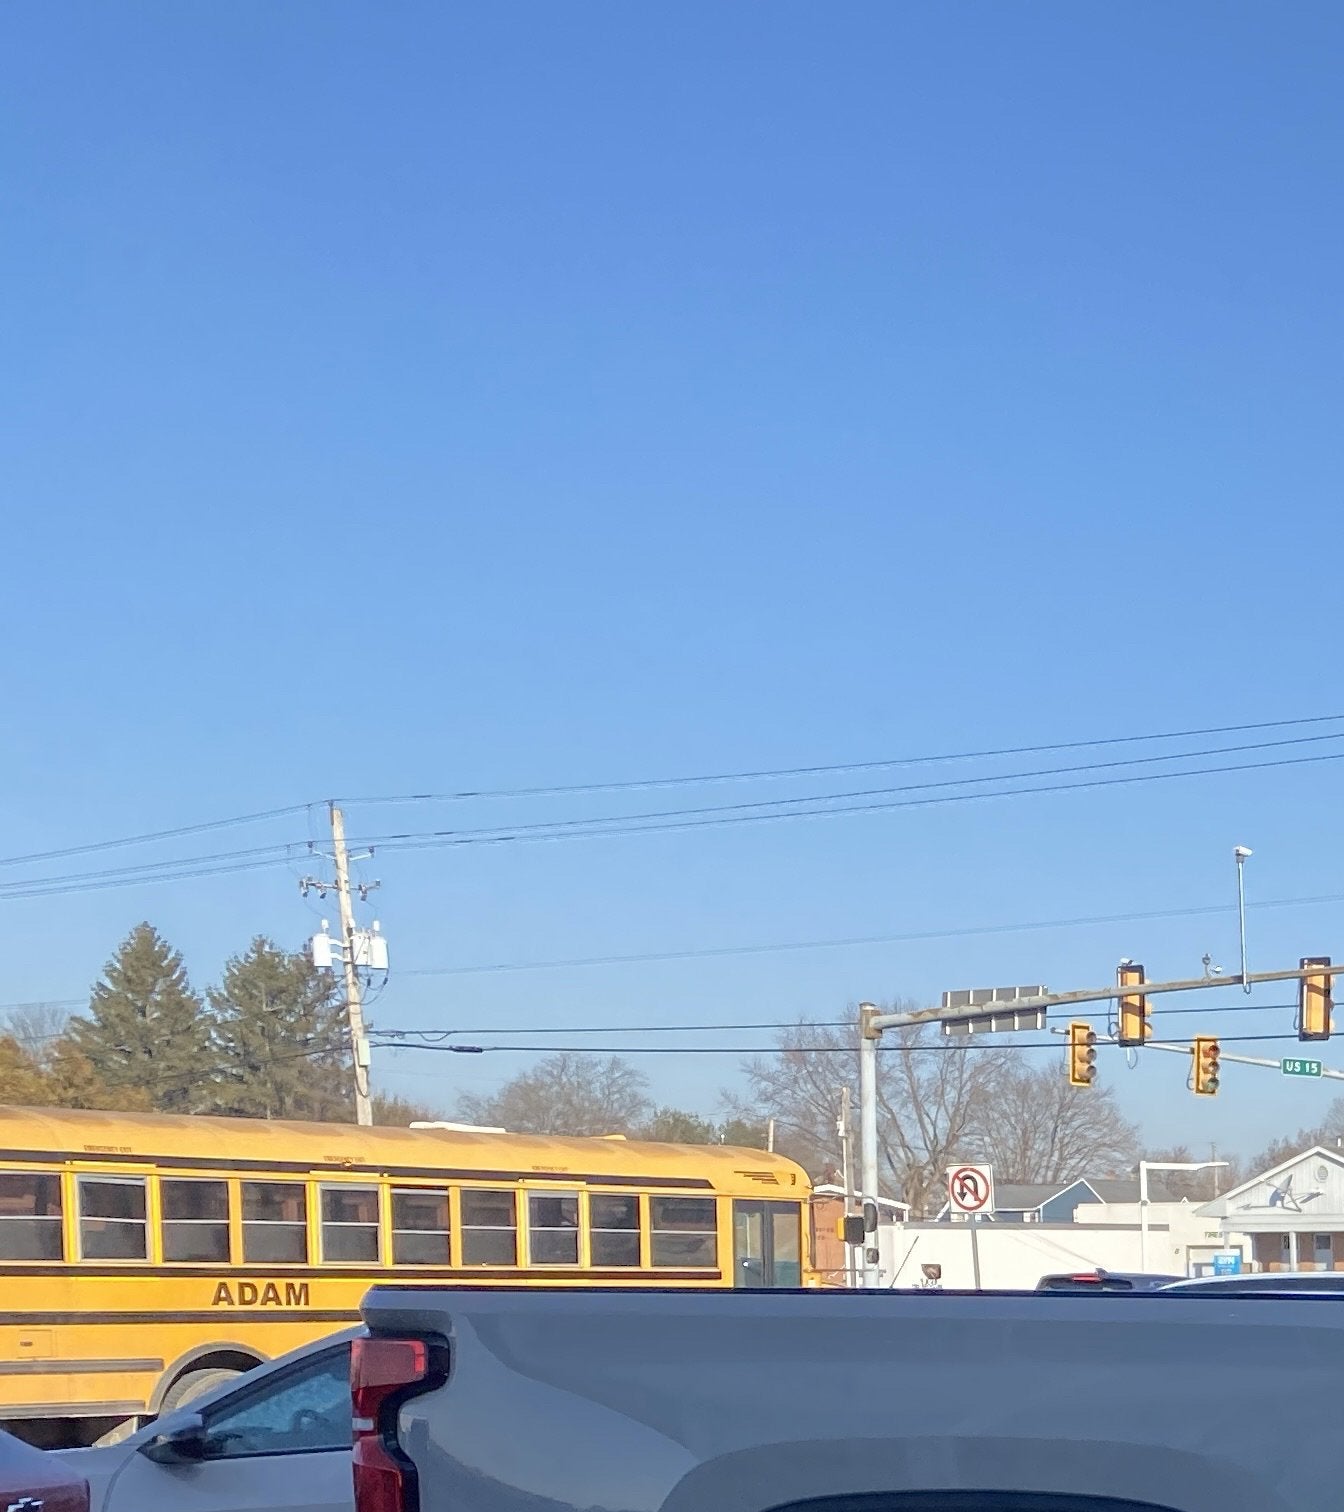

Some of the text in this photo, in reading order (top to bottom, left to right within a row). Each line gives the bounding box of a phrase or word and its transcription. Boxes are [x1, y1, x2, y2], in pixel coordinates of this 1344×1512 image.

[1286, 1061, 1318, 1074] US 15
[211, 1281, 310, 1306] ADAM
